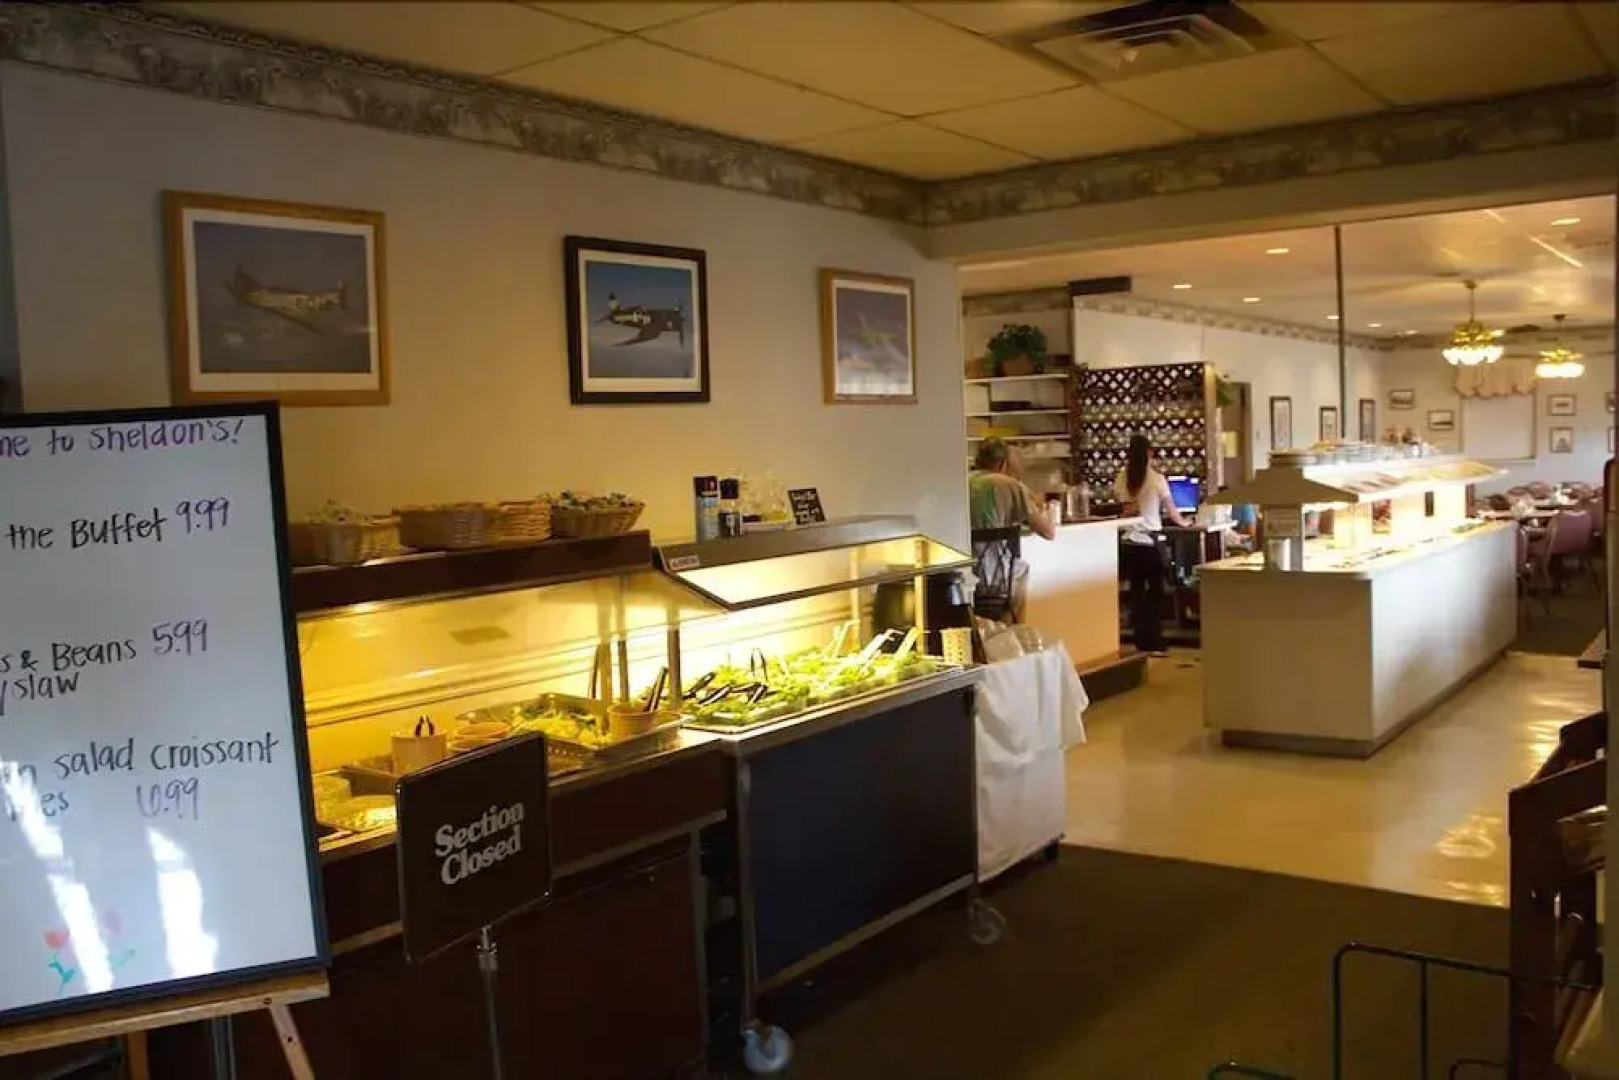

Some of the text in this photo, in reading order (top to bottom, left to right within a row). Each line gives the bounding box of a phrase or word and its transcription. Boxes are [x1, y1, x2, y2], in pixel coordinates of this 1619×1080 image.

[47, 428, 74, 455] to
[5, 497, 229, 549] the Buffet 9.99
[20, 649, 38, 671] &
[52, 639, 137, 671] Beans
[153, 619, 207, 656] 5.99
[55, 738, 133, 778] salad
[151, 732, 278, 769] croissant
[136, 777, 199, 819] 6.99
[435, 803, 524, 856] Section
[441, 825, 521, 884] Closed
